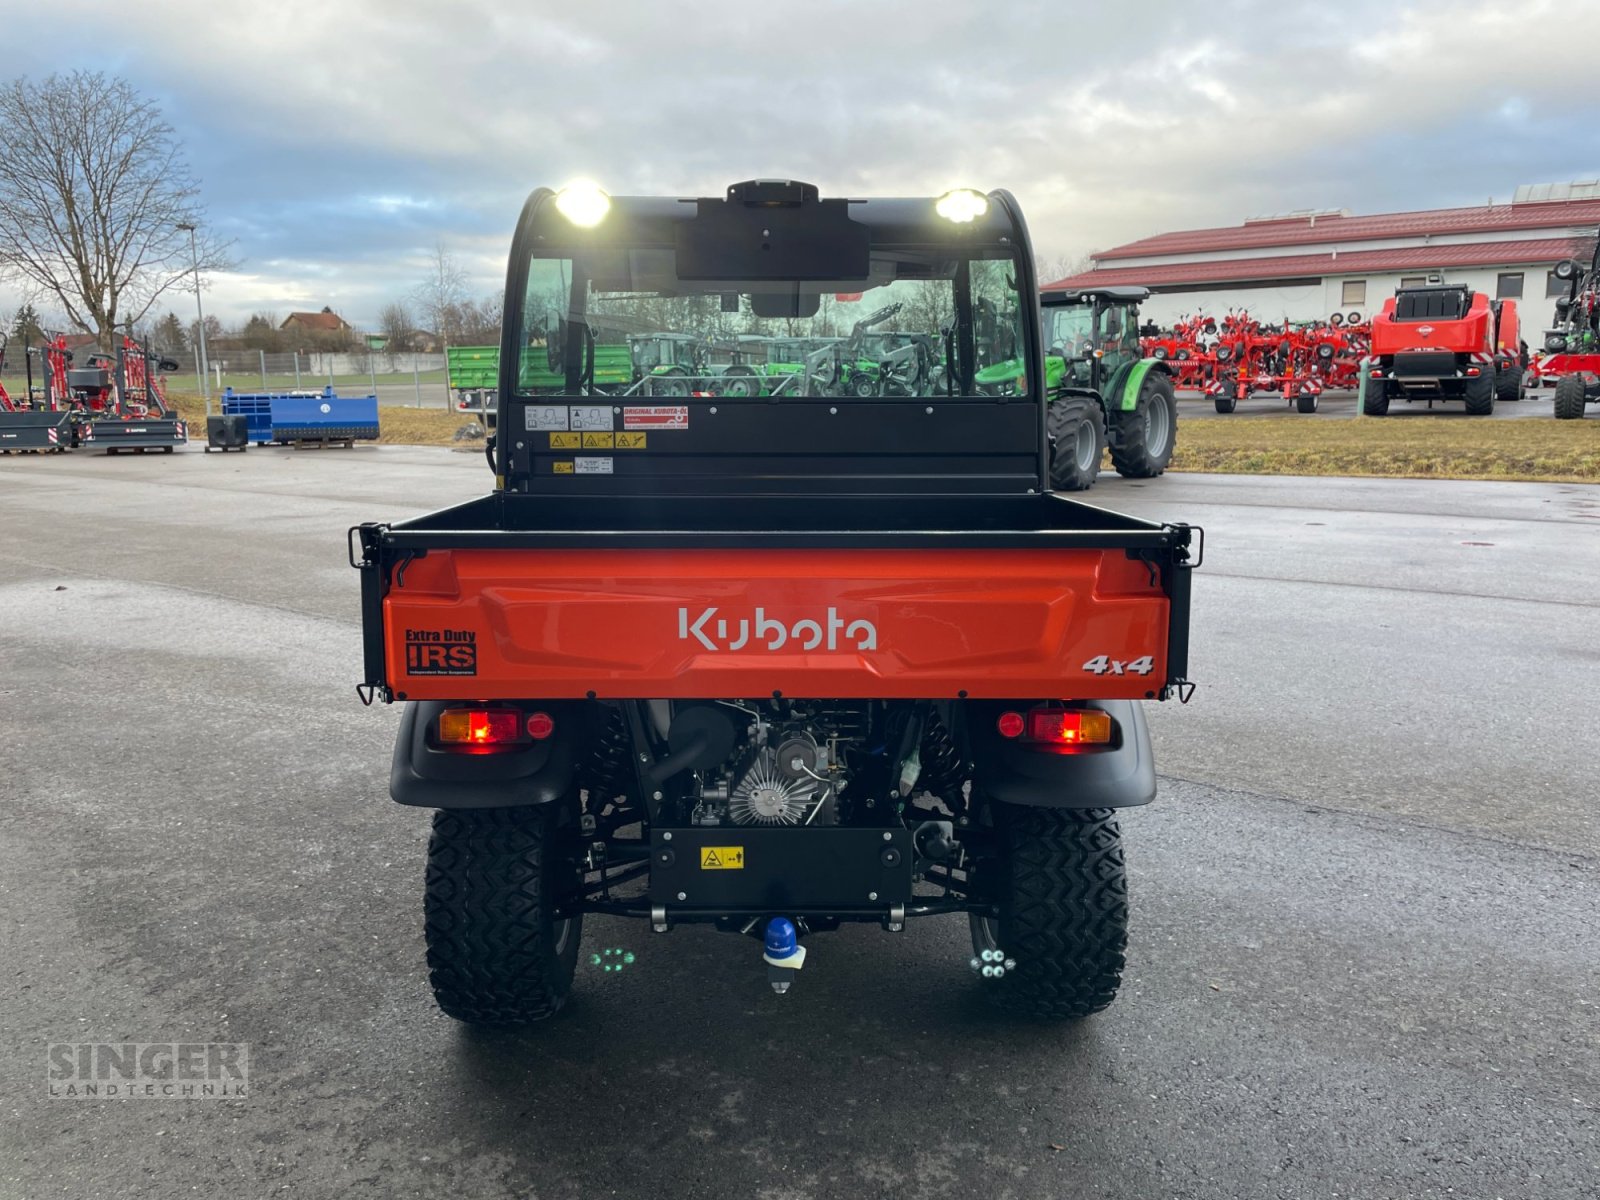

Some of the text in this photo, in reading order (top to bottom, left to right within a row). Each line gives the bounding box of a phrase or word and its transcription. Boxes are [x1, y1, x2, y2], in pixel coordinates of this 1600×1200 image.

[405, 630, 475, 642] Extra Duty
[678, 607, 877, 650] Kubota
[409, 645, 474, 668] IRS
[1082, 655, 1154, 675] 4x4
